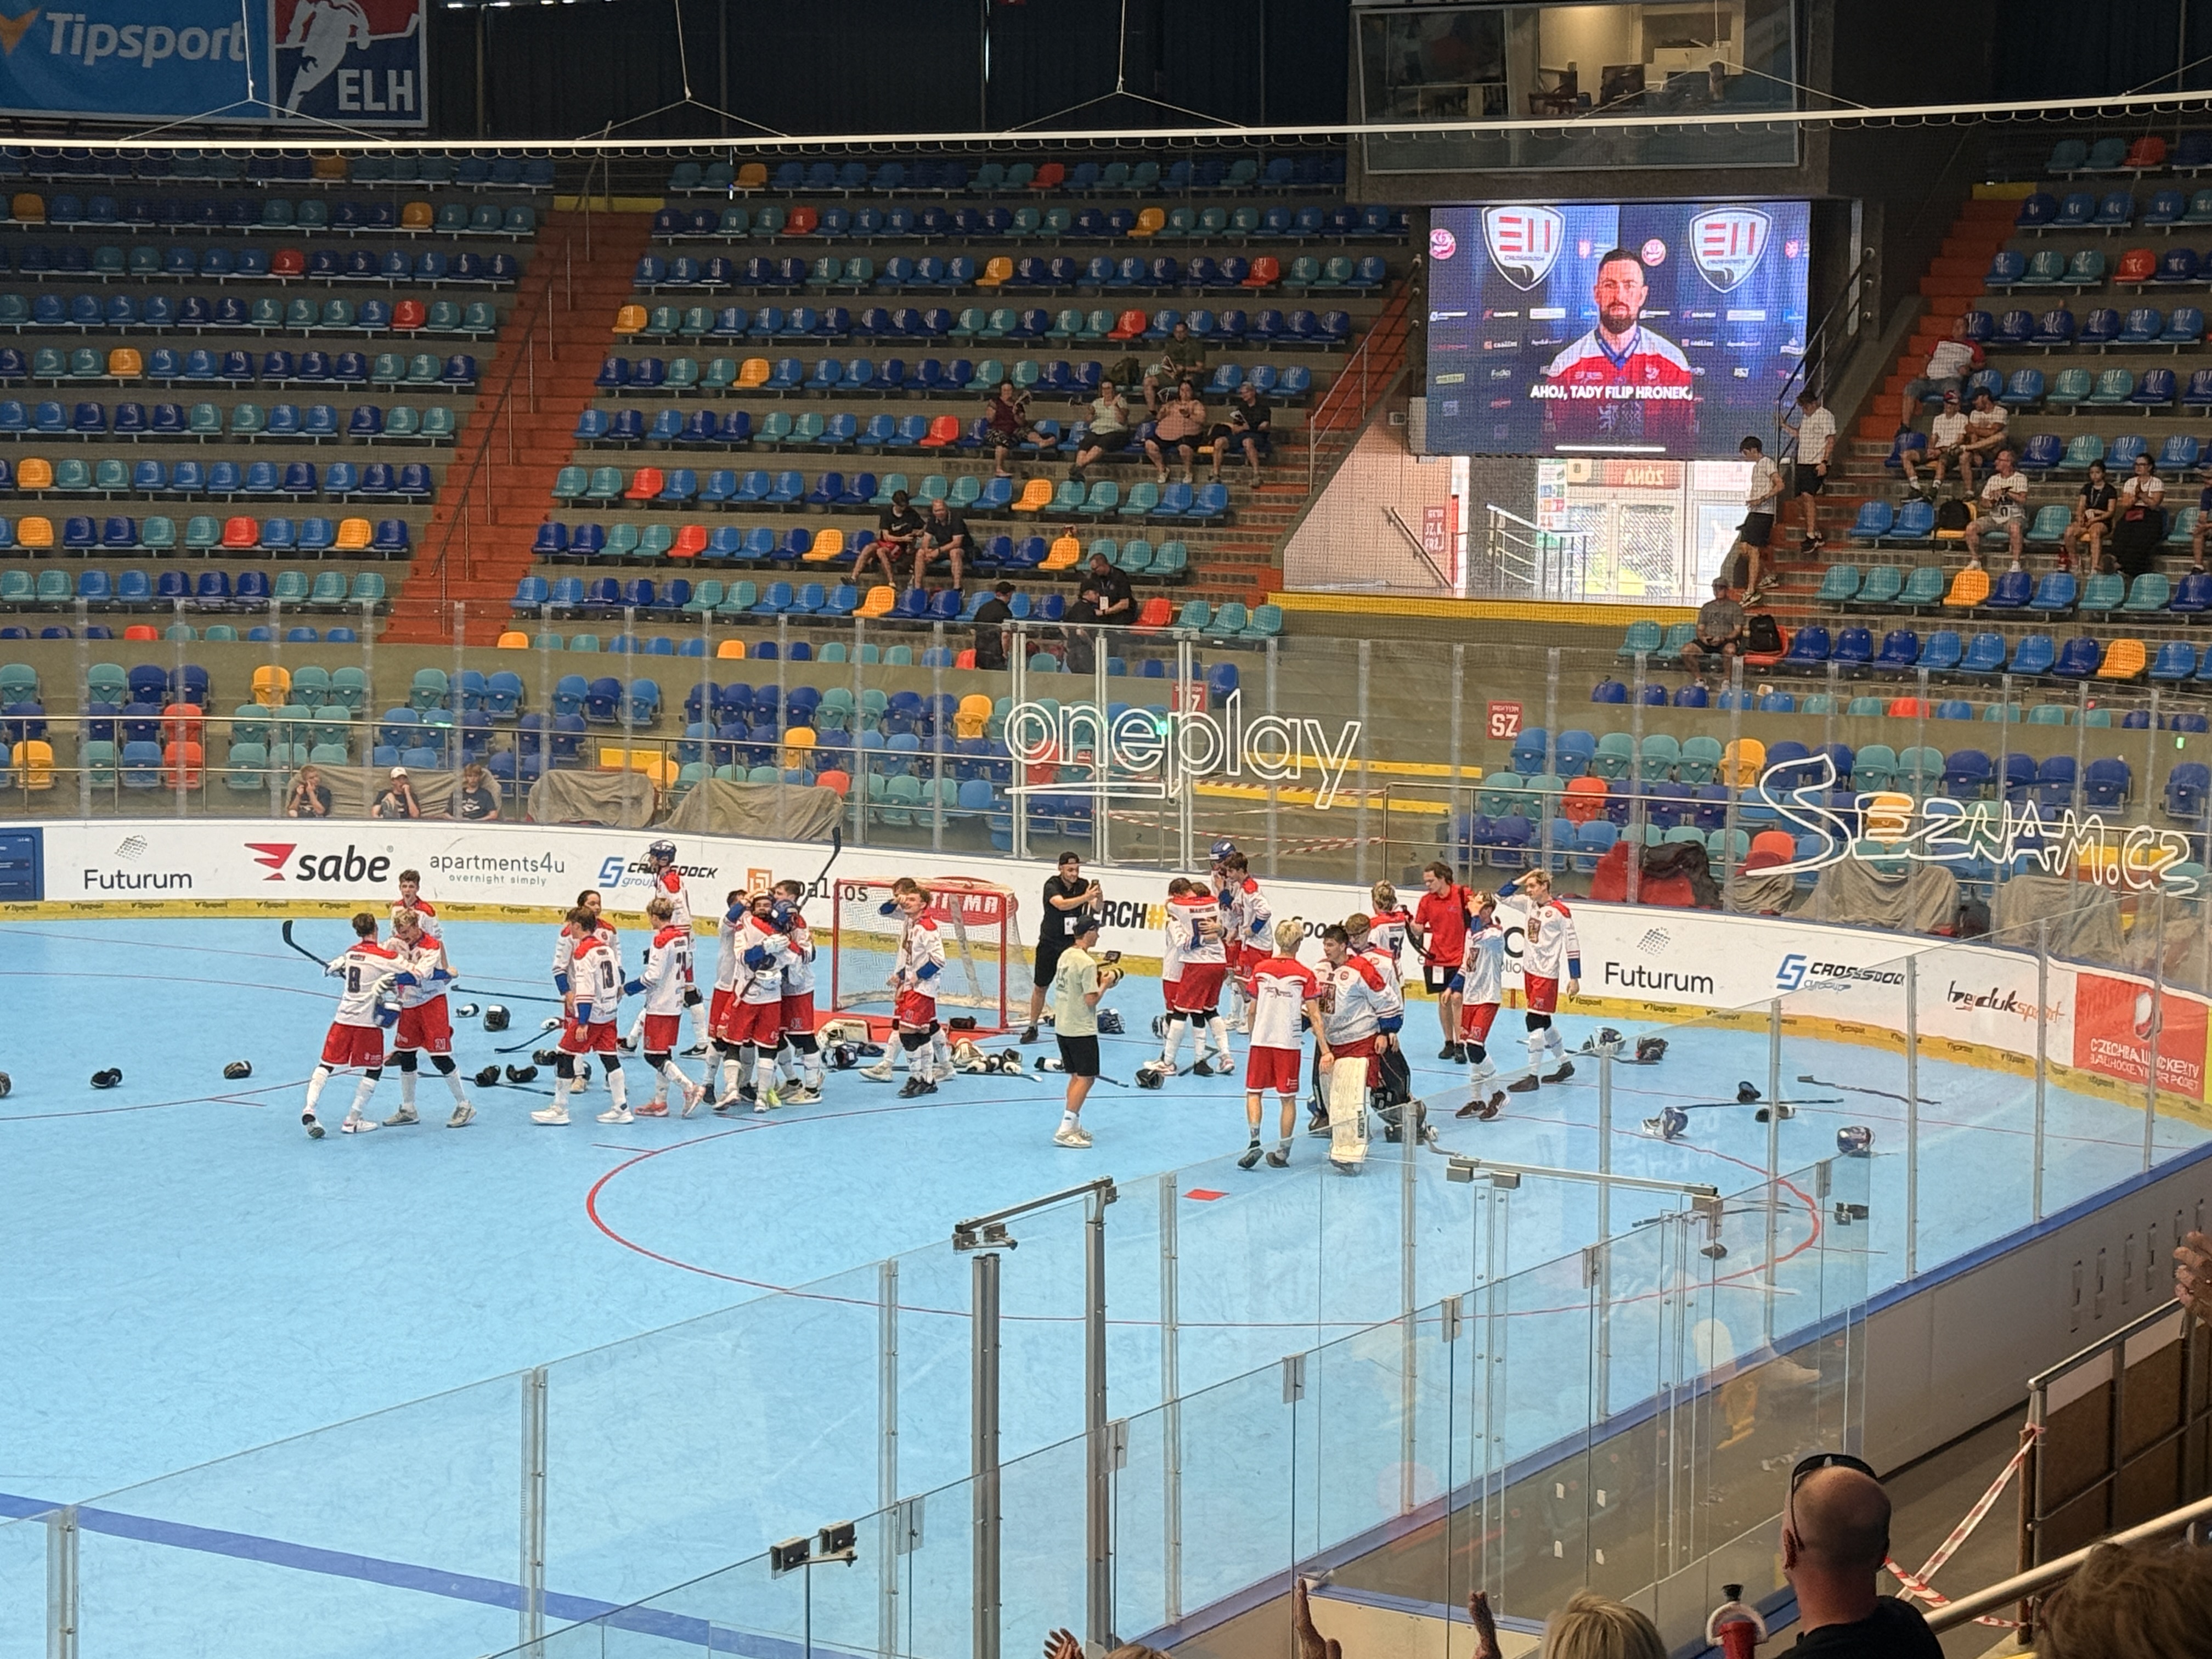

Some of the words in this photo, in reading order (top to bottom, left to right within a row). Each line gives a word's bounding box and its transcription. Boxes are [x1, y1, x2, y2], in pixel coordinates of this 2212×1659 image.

[46, 12, 246, 68] Tipsport
[337, 69, 414, 111] ELH
[1530, 385, 1568, 400] AHOJ,
[1570, 385, 1604, 399] TADY
[1605, 385, 1634, 399] FILIP
[1491, 713, 1519, 737] SZ
[1004, 688, 1362, 810] oneplay
[296, 845, 391, 883] sabe
[429, 852, 566, 874] apartments4u
[84, 869, 193, 890] Futurum
[448, 873, 506, 885] overnight
[510, 874, 548, 888] simply
[1604, 962, 1714, 995] Futurum
